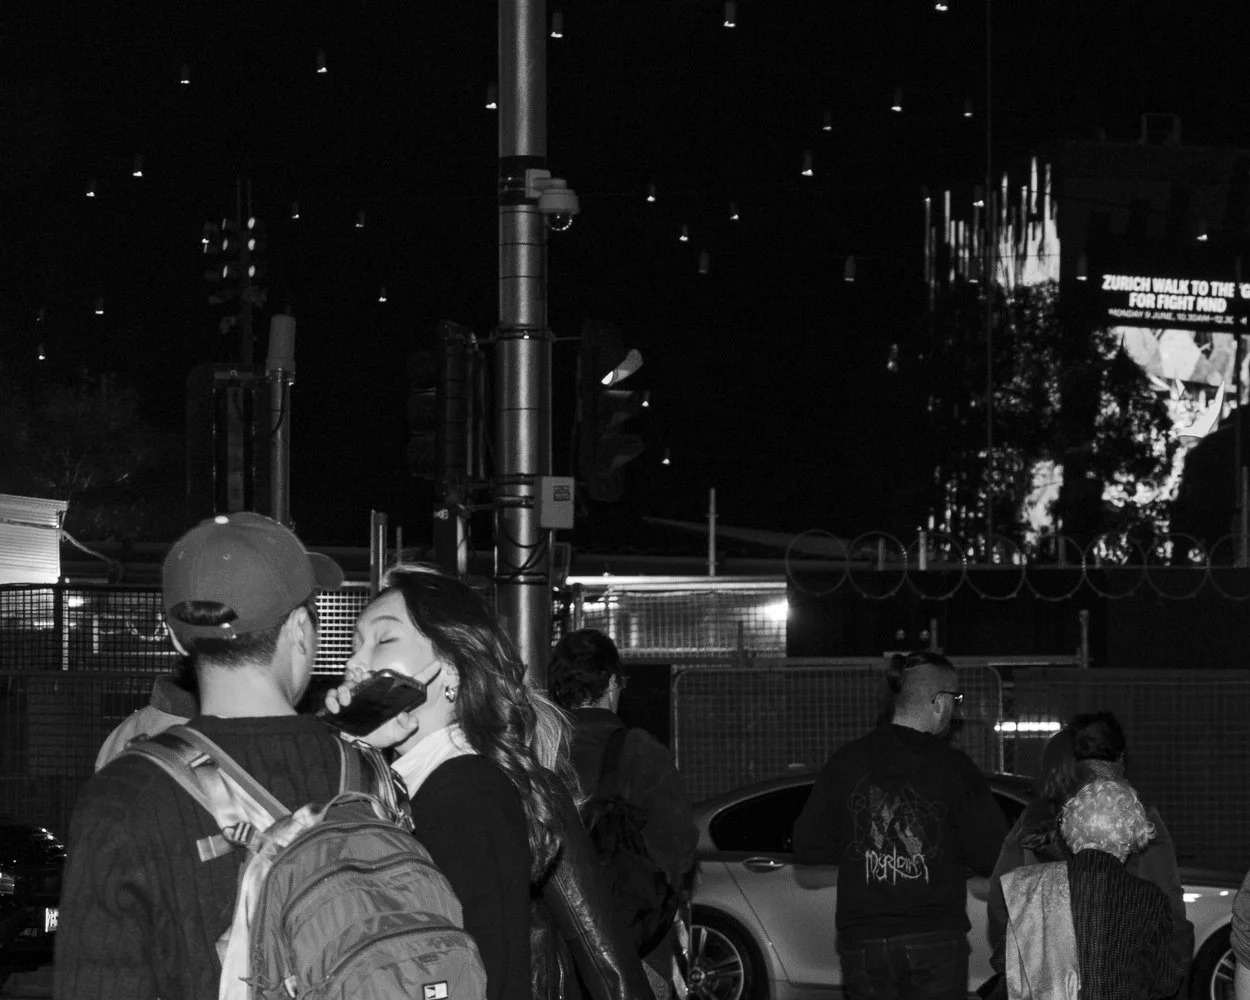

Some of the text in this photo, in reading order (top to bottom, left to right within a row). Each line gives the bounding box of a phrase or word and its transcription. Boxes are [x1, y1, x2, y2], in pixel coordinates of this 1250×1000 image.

[1102, 274, 1151, 292] ZURICH
[1152, 278, 1189, 295] WALK
[1191, 280, 1210, 296] TO
[1211, 282, 1235, 298] THE
[1128, 293, 1228, 313] FOR FIGHT MND
[1108, 308, 1143, 319] MONDAY
[1144, 311, 1151, 320] 9
